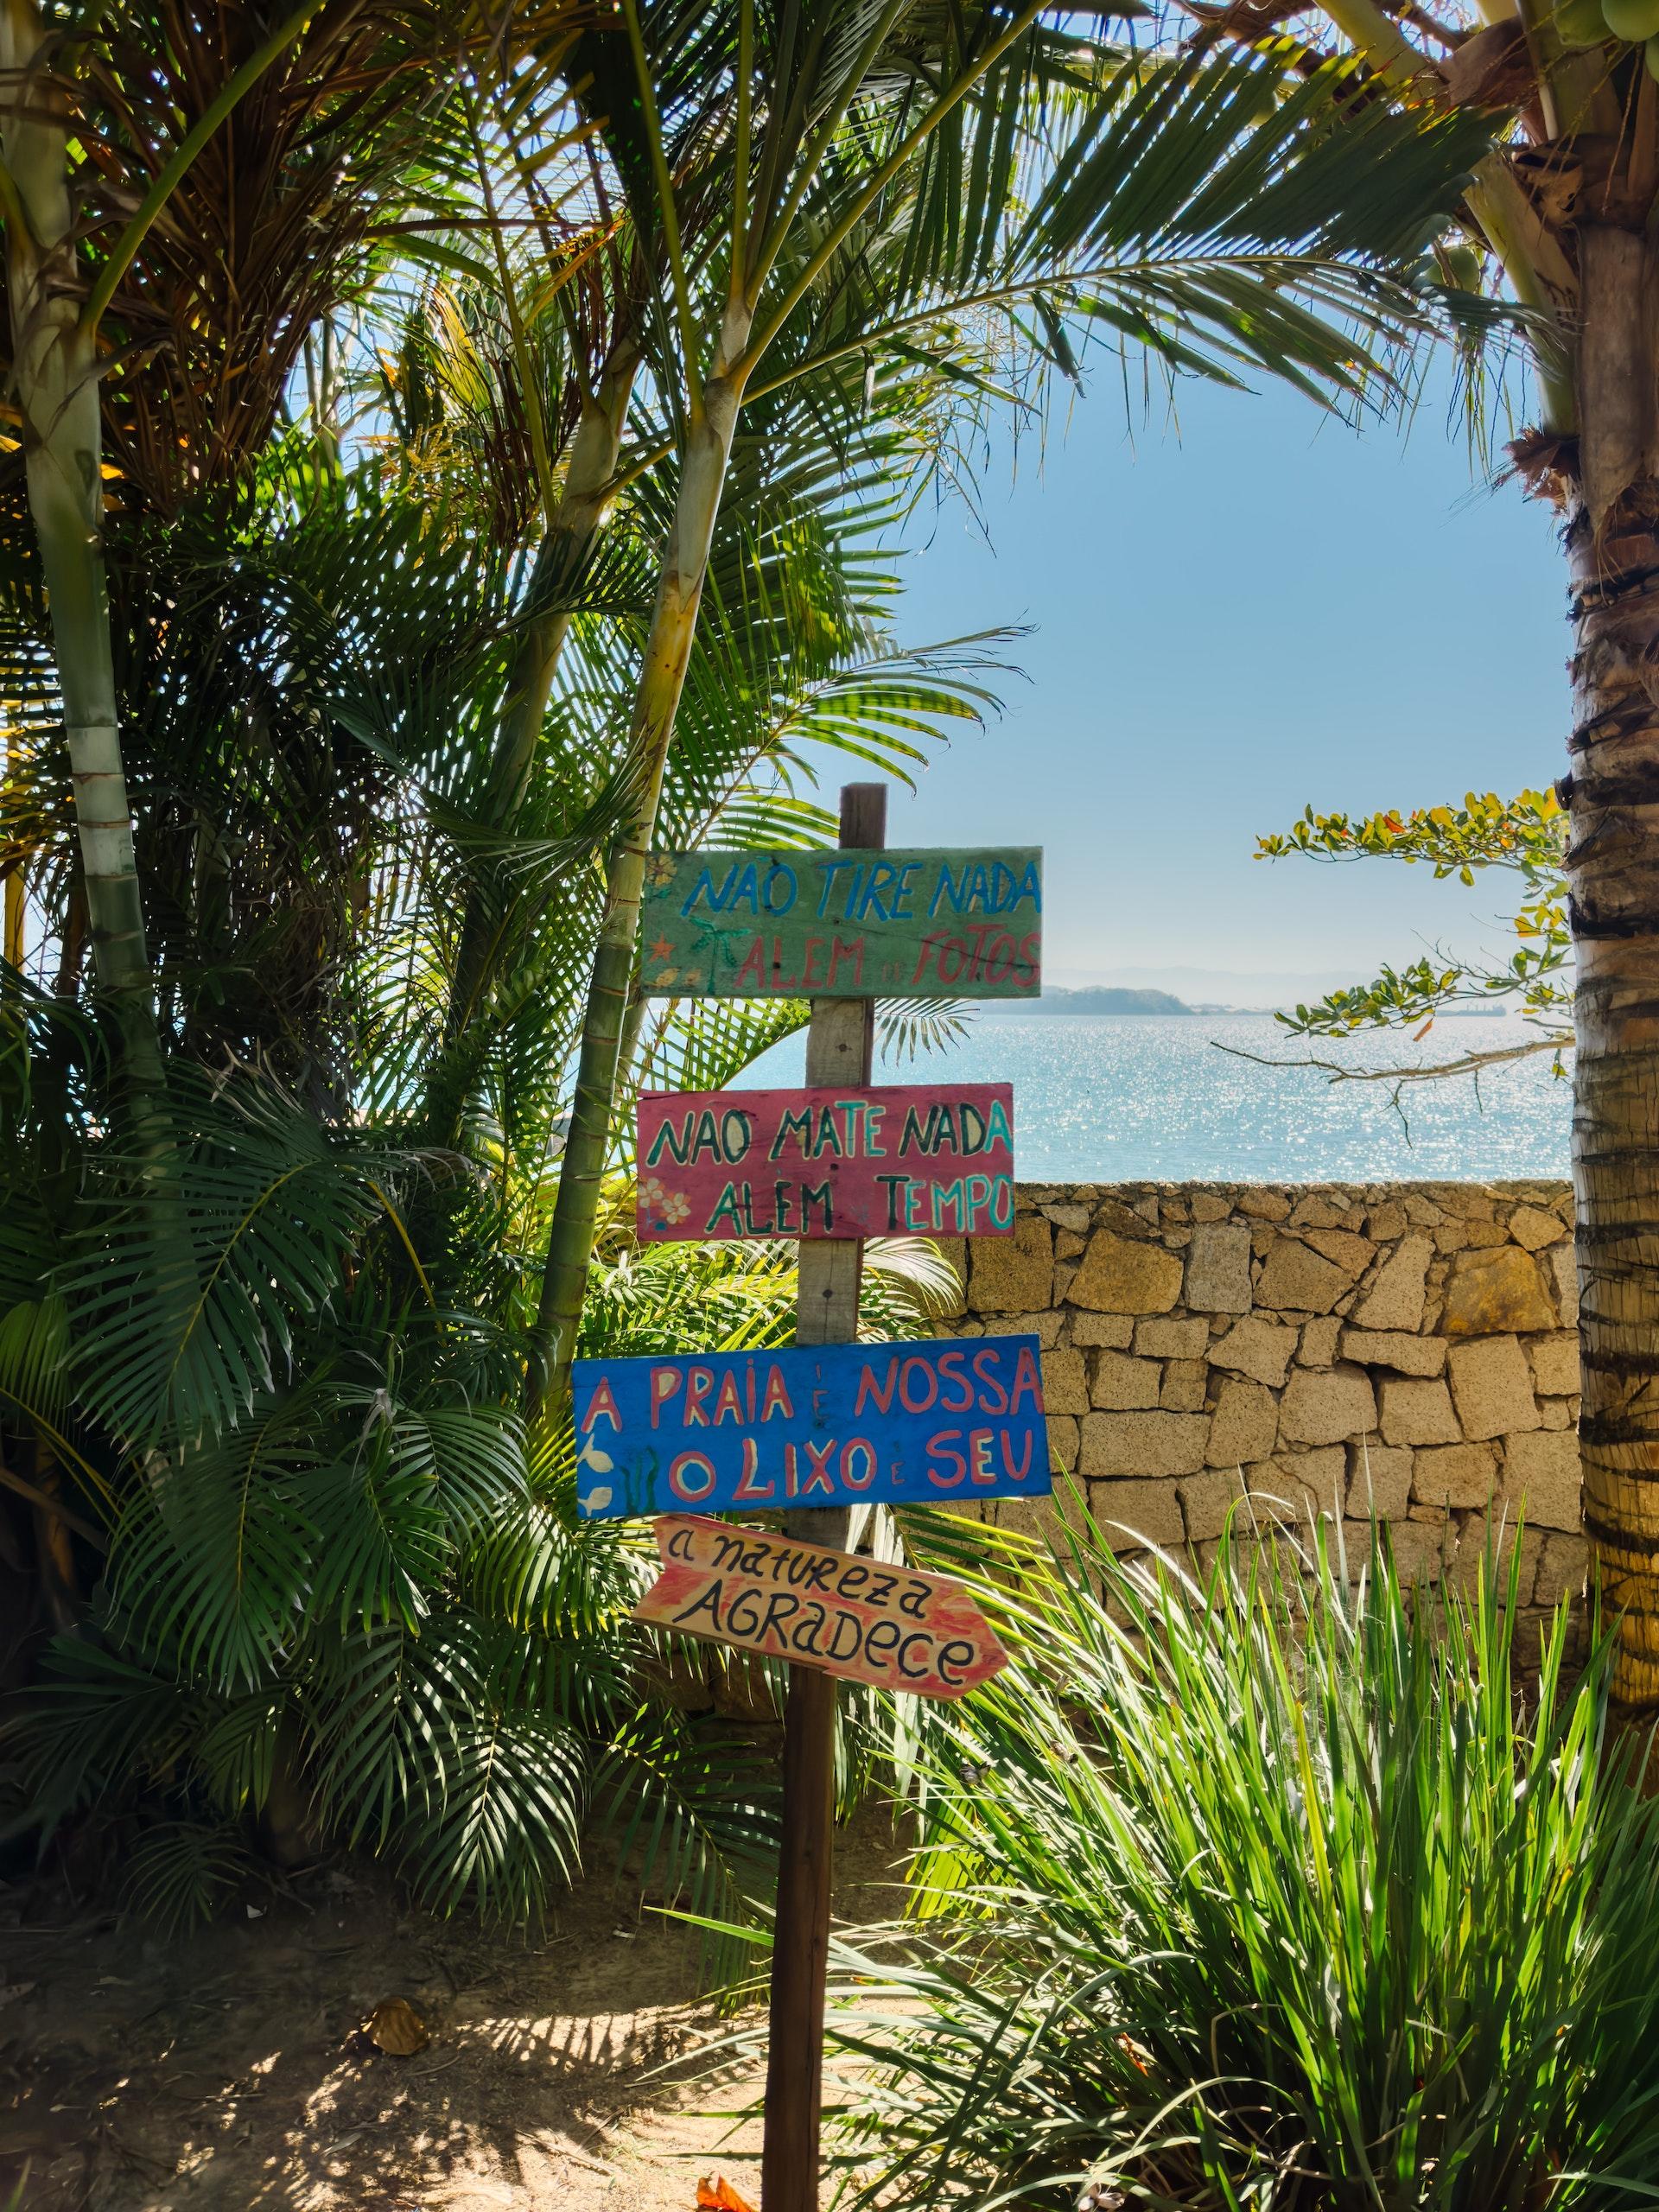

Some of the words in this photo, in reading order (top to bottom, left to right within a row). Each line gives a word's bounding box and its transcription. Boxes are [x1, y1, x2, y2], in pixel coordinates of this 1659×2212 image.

[817, 860, 922, 921] TIRE
[928, 861, 1041, 918] NADA
[911, 924, 1041, 988] FOTOS
[768, 1100, 888, 1161] MATE
[898, 1099, 1014, 1159] NADA
[704, 1180, 834, 1236] ALEM
[874, 1174, 1014, 1233] TEMPO
[581, 1376, 623, 1433] A
[855, 1346, 1044, 1417] NOSSA
[669, 1451, 716, 1503] O
[733, 1438, 877, 1501] LIXO
[925, 1427, 1033, 1489] SEU
